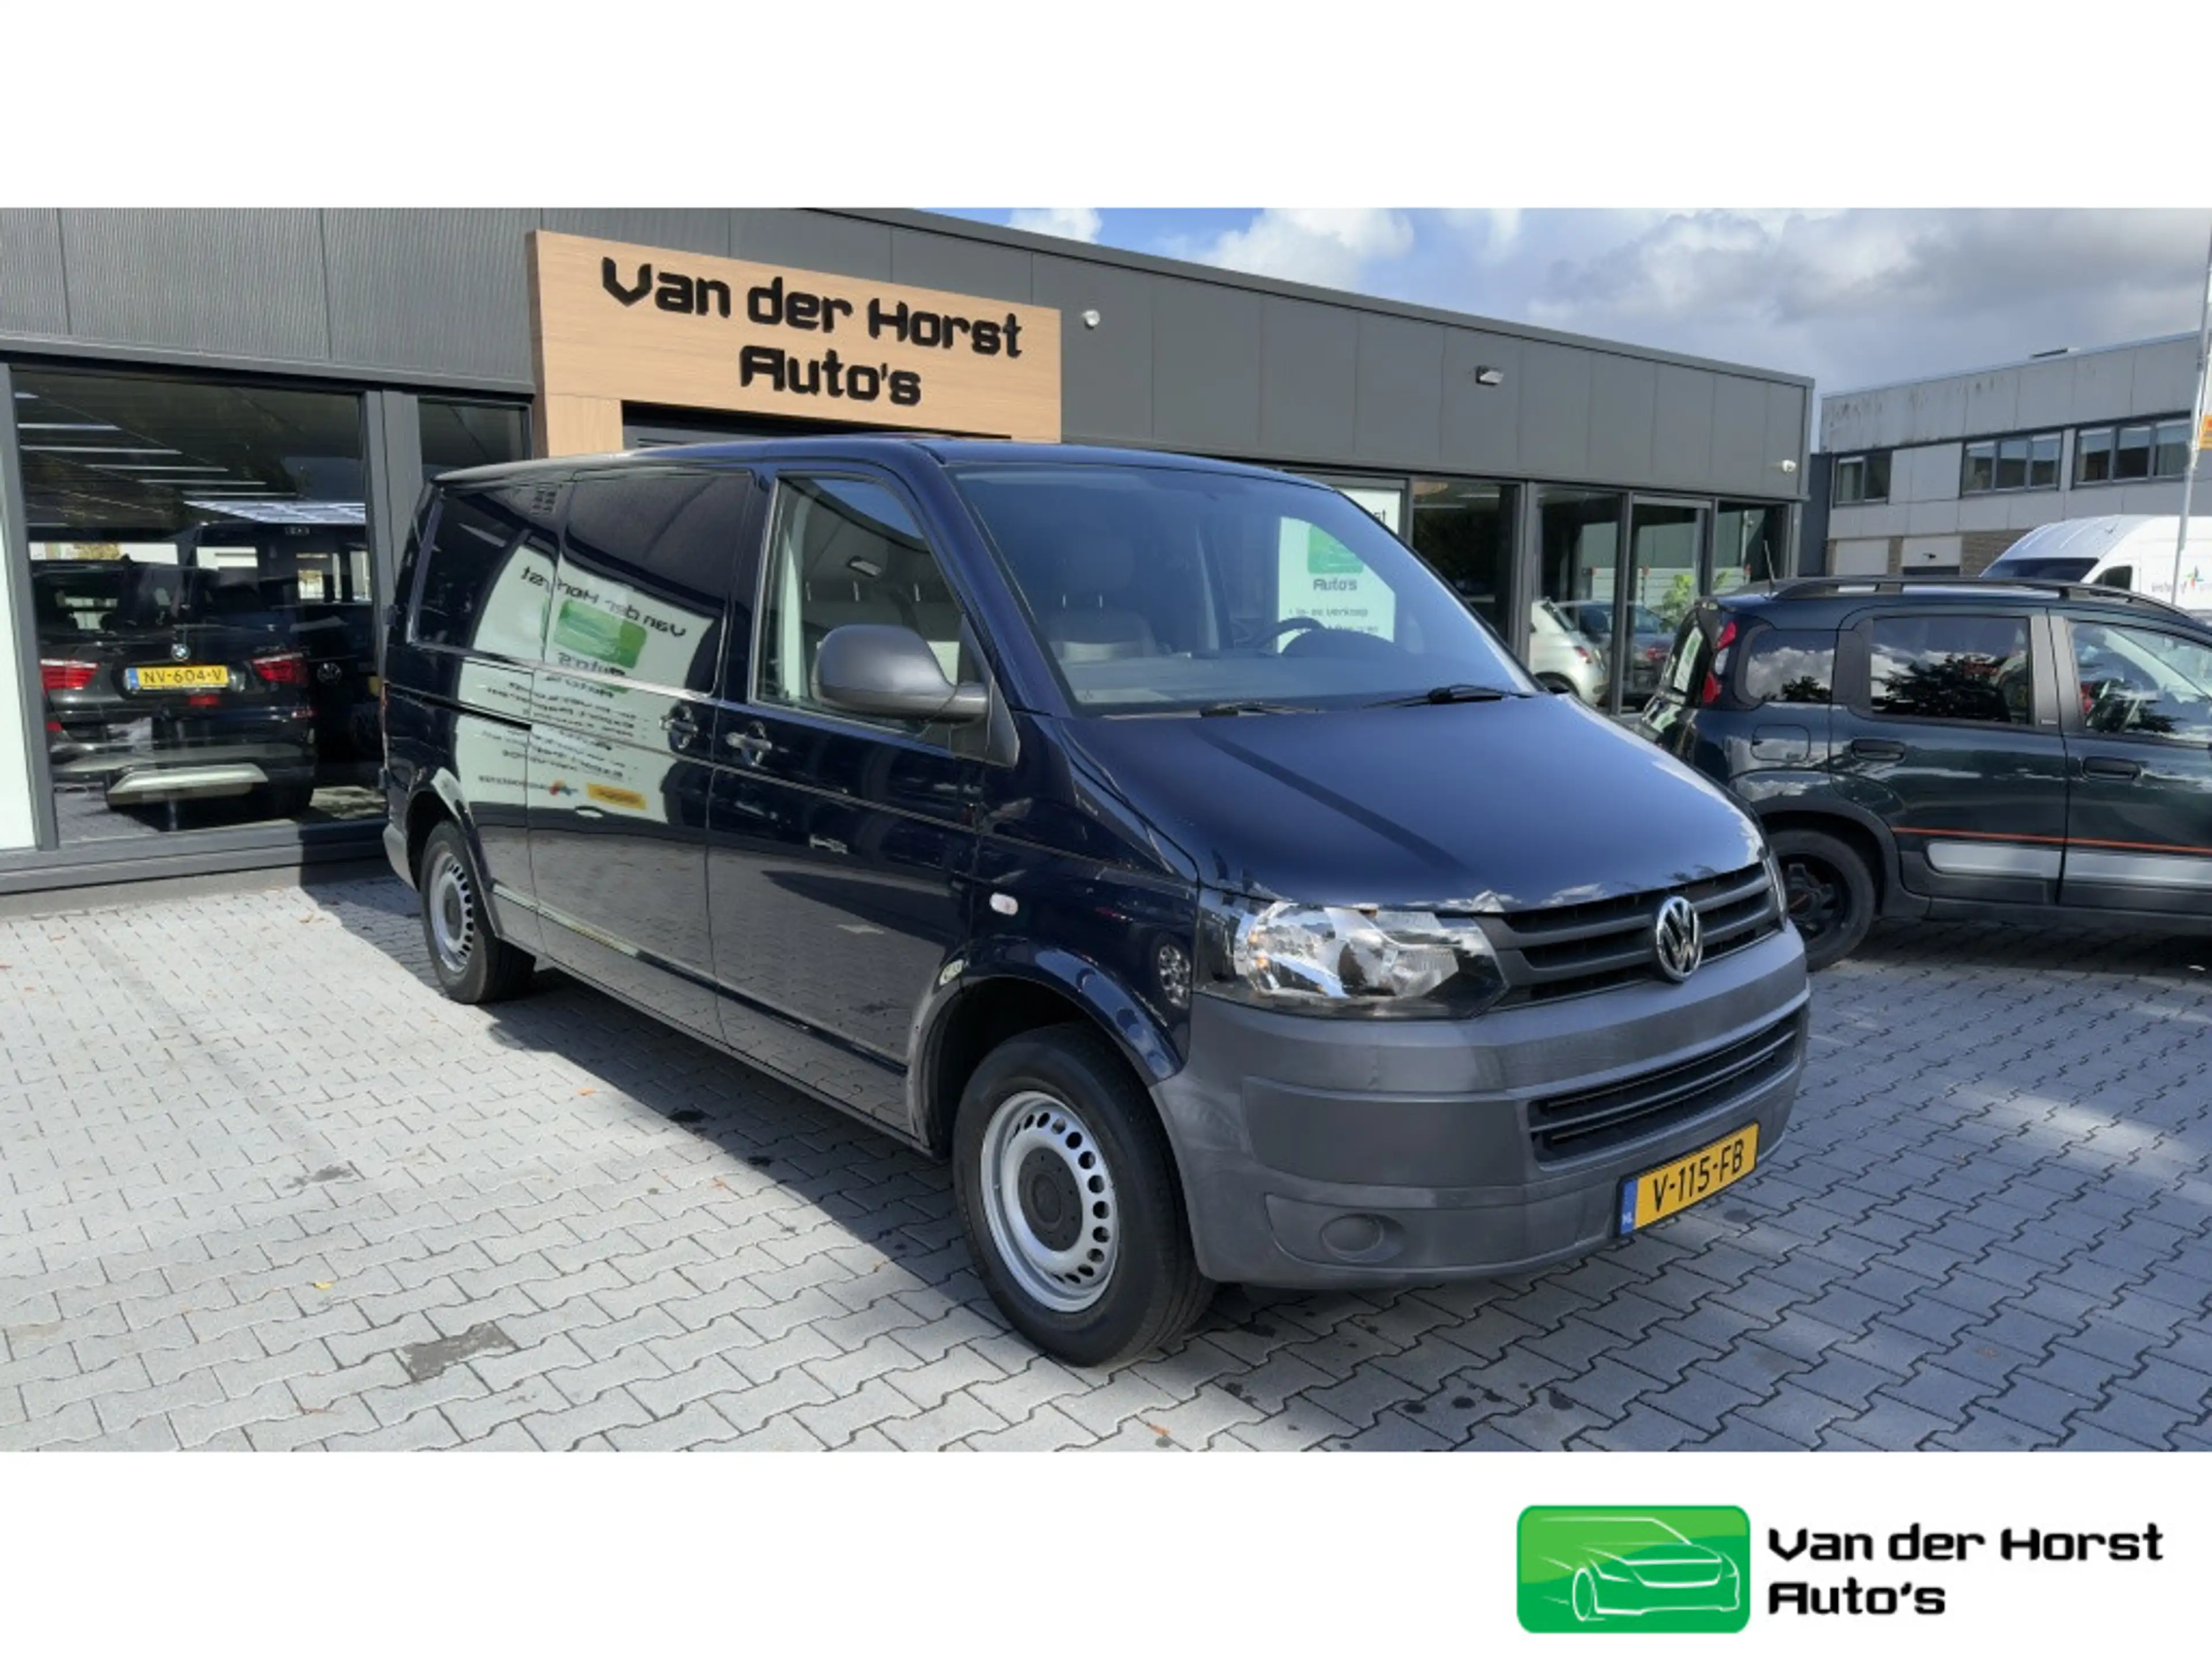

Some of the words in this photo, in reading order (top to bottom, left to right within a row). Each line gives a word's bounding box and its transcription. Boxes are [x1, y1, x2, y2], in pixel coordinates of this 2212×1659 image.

[601, 257, 731, 318] Van
[747, 276, 853, 333] der
[868, 298, 1022, 358] Horst
[740, 346, 921, 406] Auto's
[1312, 578, 1358, 591] Auto's
[144, 669, 222, 684] NV-604-V
[1653, 1138, 1744, 1213] V-115-FB
